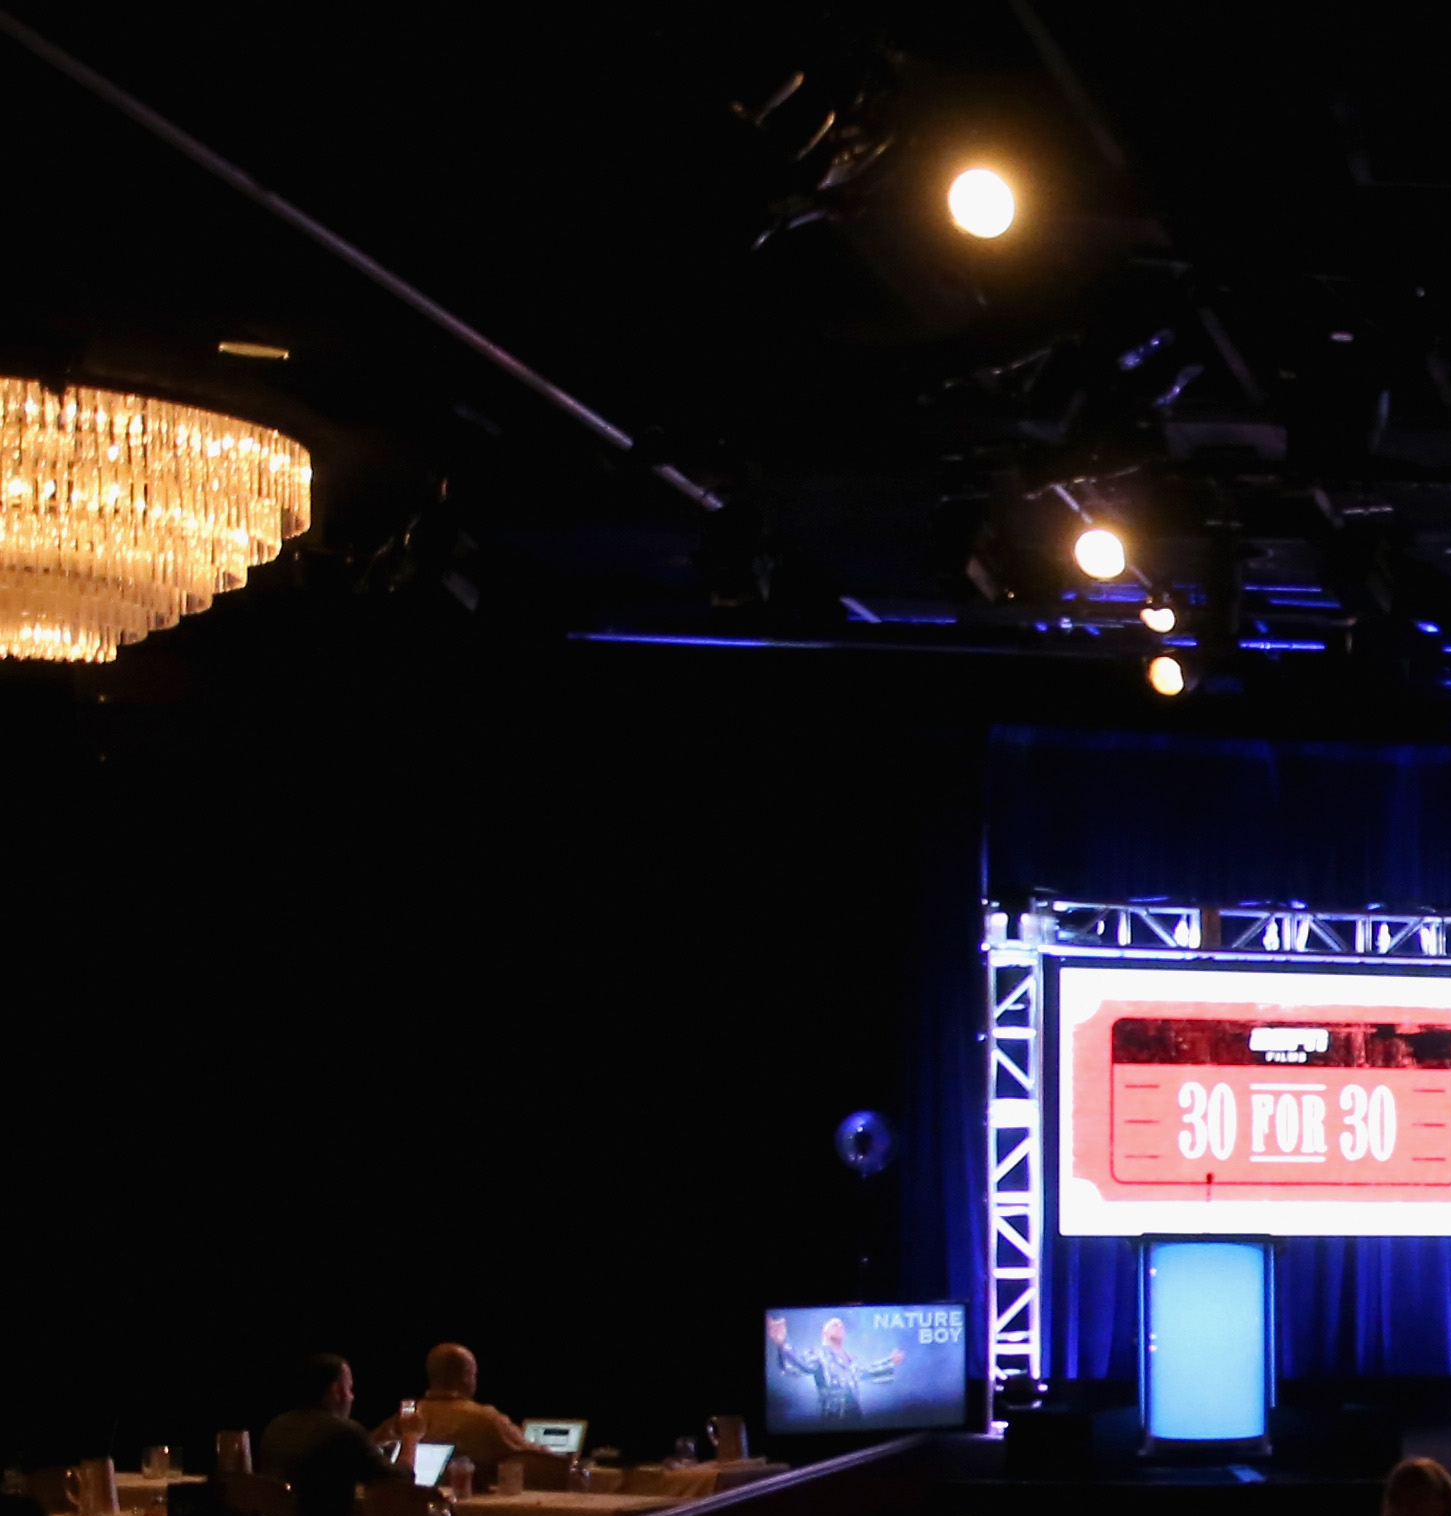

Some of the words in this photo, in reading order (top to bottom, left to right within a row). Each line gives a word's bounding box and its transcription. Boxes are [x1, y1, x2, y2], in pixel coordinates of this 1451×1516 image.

[1178, 1081, 1238, 1161] 30
[1250, 1093, 1328, 1154] FOR
[1339, 1084, 1398, 1162] 30
[873, 1311, 963, 1329] NATURE
[919, 1328, 962, 1344] BOY
